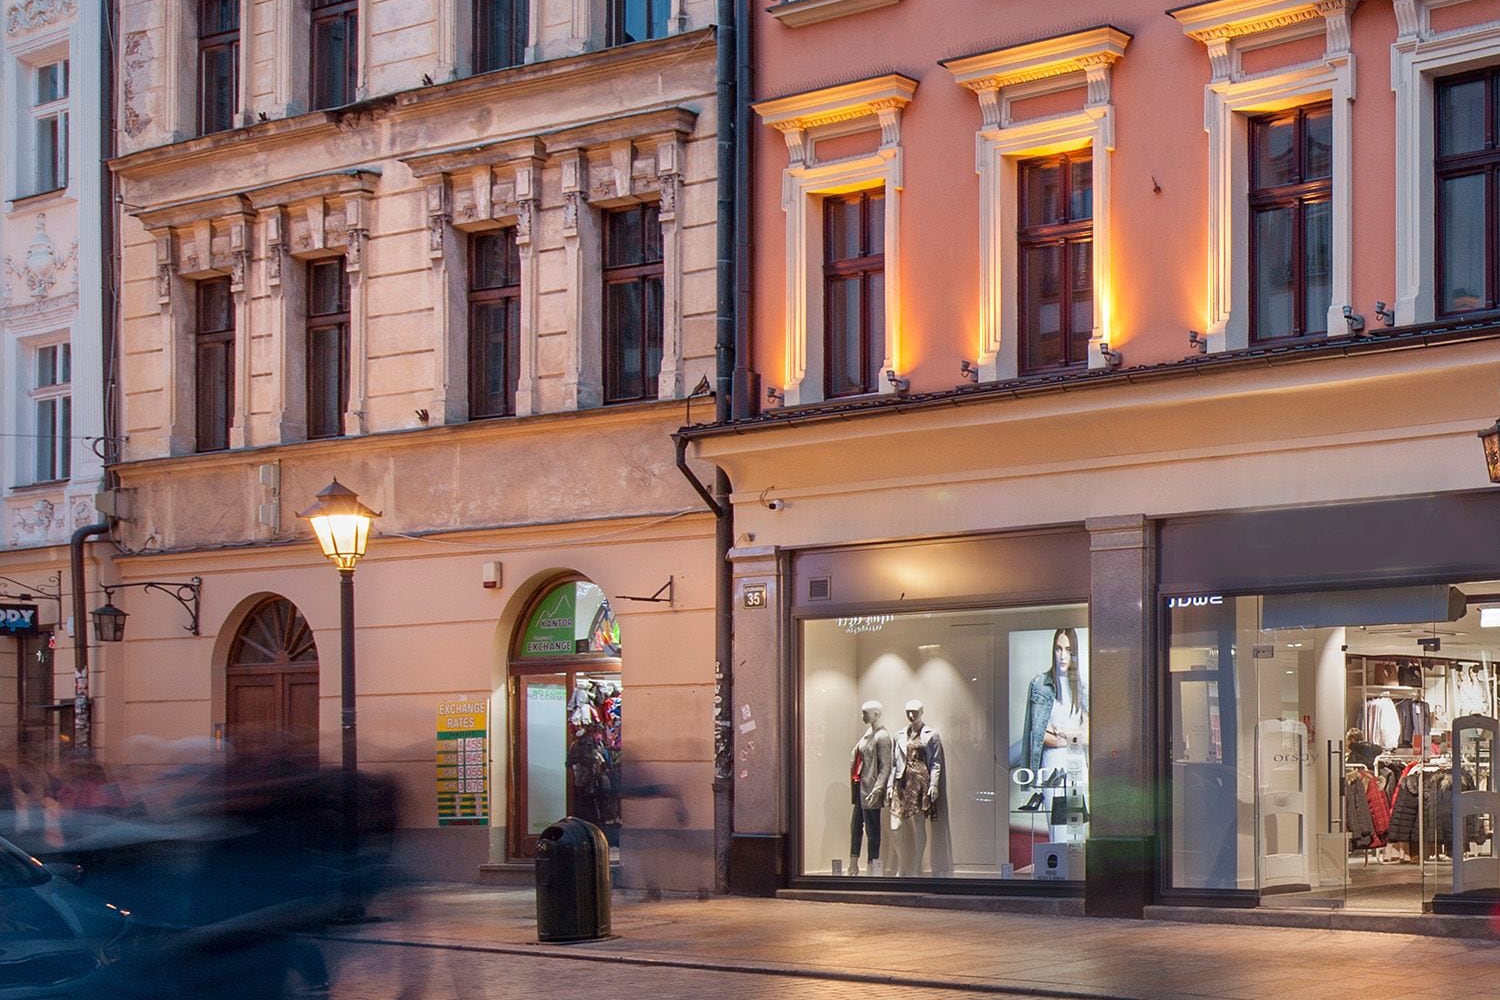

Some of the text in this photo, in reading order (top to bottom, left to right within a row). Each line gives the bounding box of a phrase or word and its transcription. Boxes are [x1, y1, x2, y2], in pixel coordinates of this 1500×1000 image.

[747, 592, 761, 605] 35
[541, 619, 573, 630] KANTOR
[528, 641, 572, 652] EXCHANGE
[439, 703, 485, 715] EXCHANGE
[447, 717, 475, 728] RATES
[1273, 753, 1319, 766] orsay
